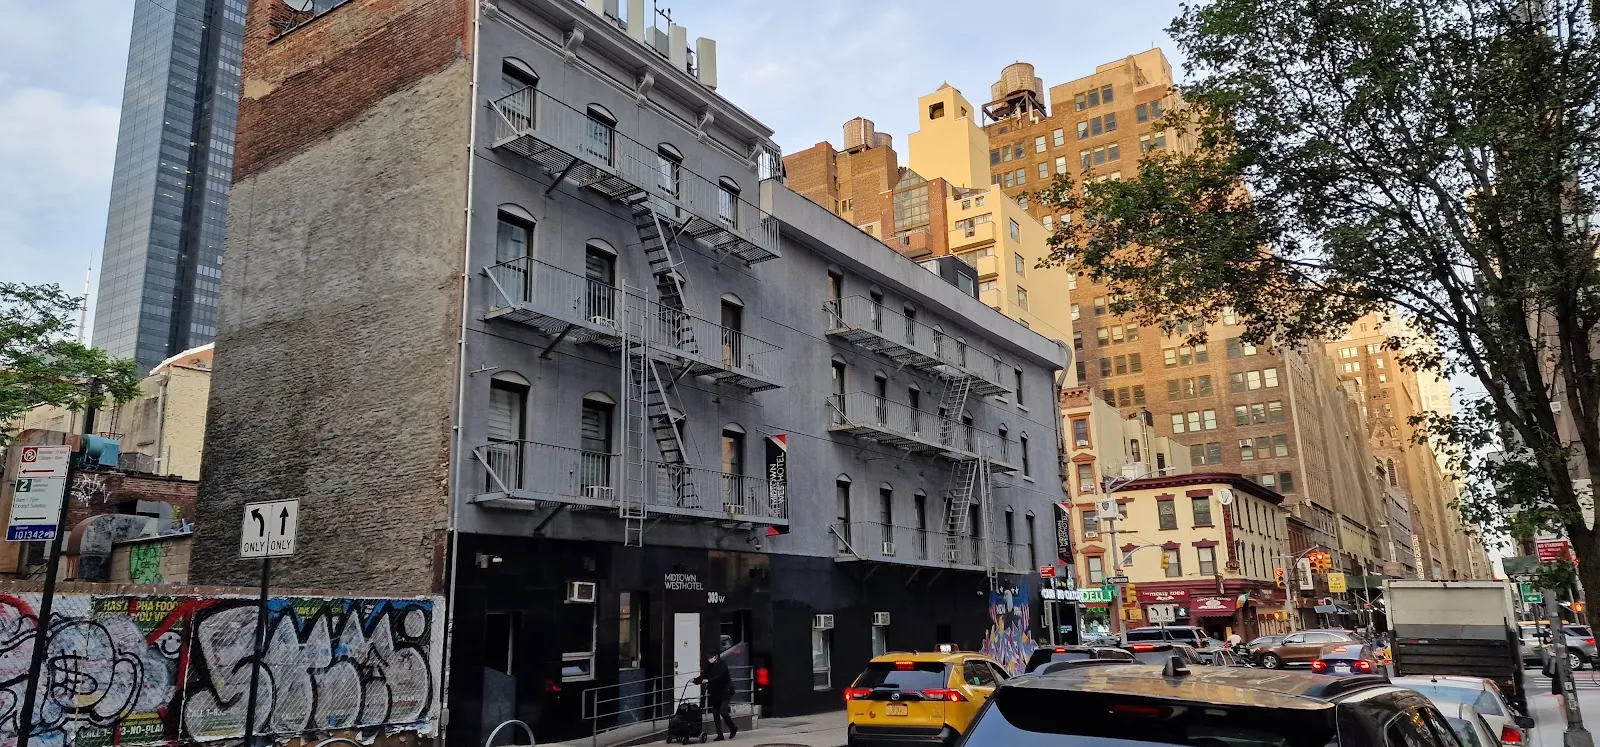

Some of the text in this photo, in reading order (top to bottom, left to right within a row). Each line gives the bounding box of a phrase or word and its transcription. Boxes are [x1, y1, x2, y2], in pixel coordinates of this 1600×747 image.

[14, 530, 44, 540] 101342
[244, 540, 292, 552] ONLY ONLY
[664, 574, 696, 582] MIDTOWN
[708, 592, 718, 604] 303
[1083, 591, 1104, 600] DELI
